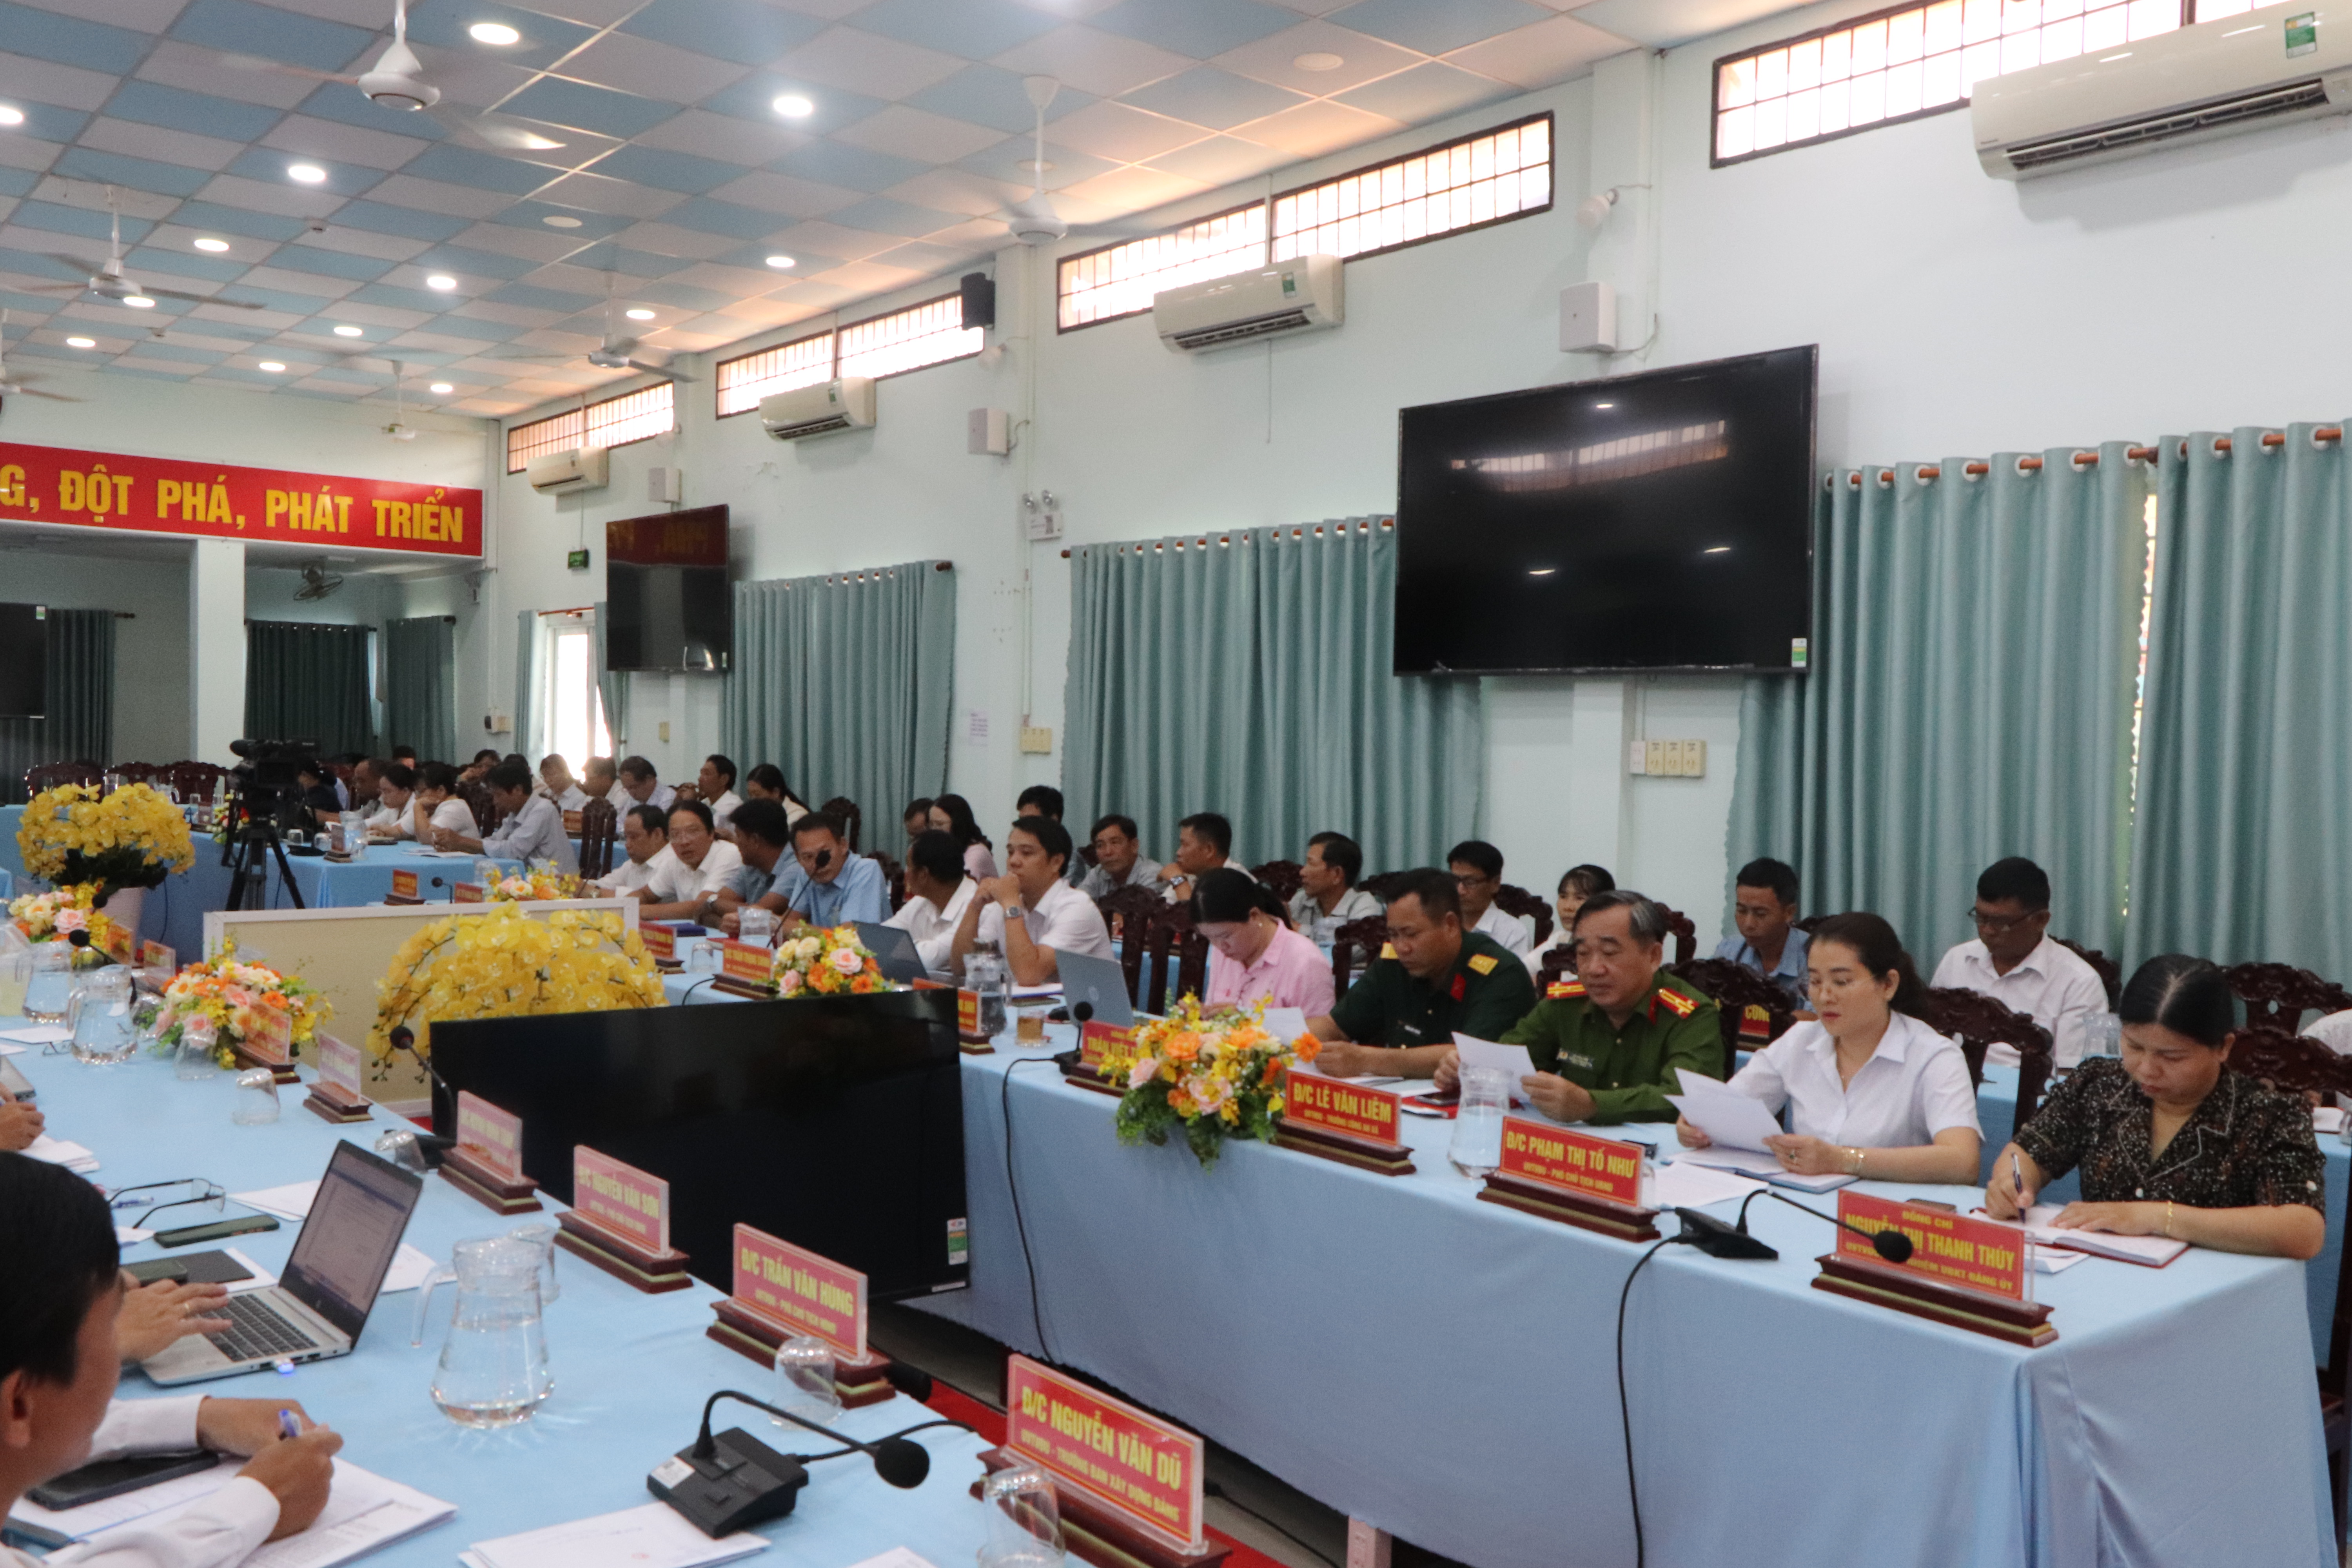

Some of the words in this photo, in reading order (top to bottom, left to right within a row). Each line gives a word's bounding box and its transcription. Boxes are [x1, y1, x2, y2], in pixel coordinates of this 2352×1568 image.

[59, 464, 133, 523] ĐỘT
[157, 474, 245, 530] PHÁ,
[265, 485, 354, 534] PHÁT
[372, 488, 463, 543] TRIỂN
[1294, 1082, 1314, 1105] Đ/C
[1316, 1085, 1330, 1109] LÊ
[1333, 1090, 1358, 1115] VĂN
[1506, 1131, 1526, 1152] Đ/C
[1529, 1136, 1564, 1162] PHẠM
[1567, 1145, 1586, 1171] THỊ
[1589, 1146, 1605, 1171] TỐ
[1608, 1155, 1636, 1178] NHƯ
[1928, 1232, 1975, 1262] THANH
[794, 1269, 818, 1302] VĂN
[1022, 1386, 1047, 1423] Đ/C
[1051, 1400, 1115, 1457] NGUYỄN
[1118, 1432, 1153, 1477] VĂN
[1157, 1452, 1182, 1490] DŨ
